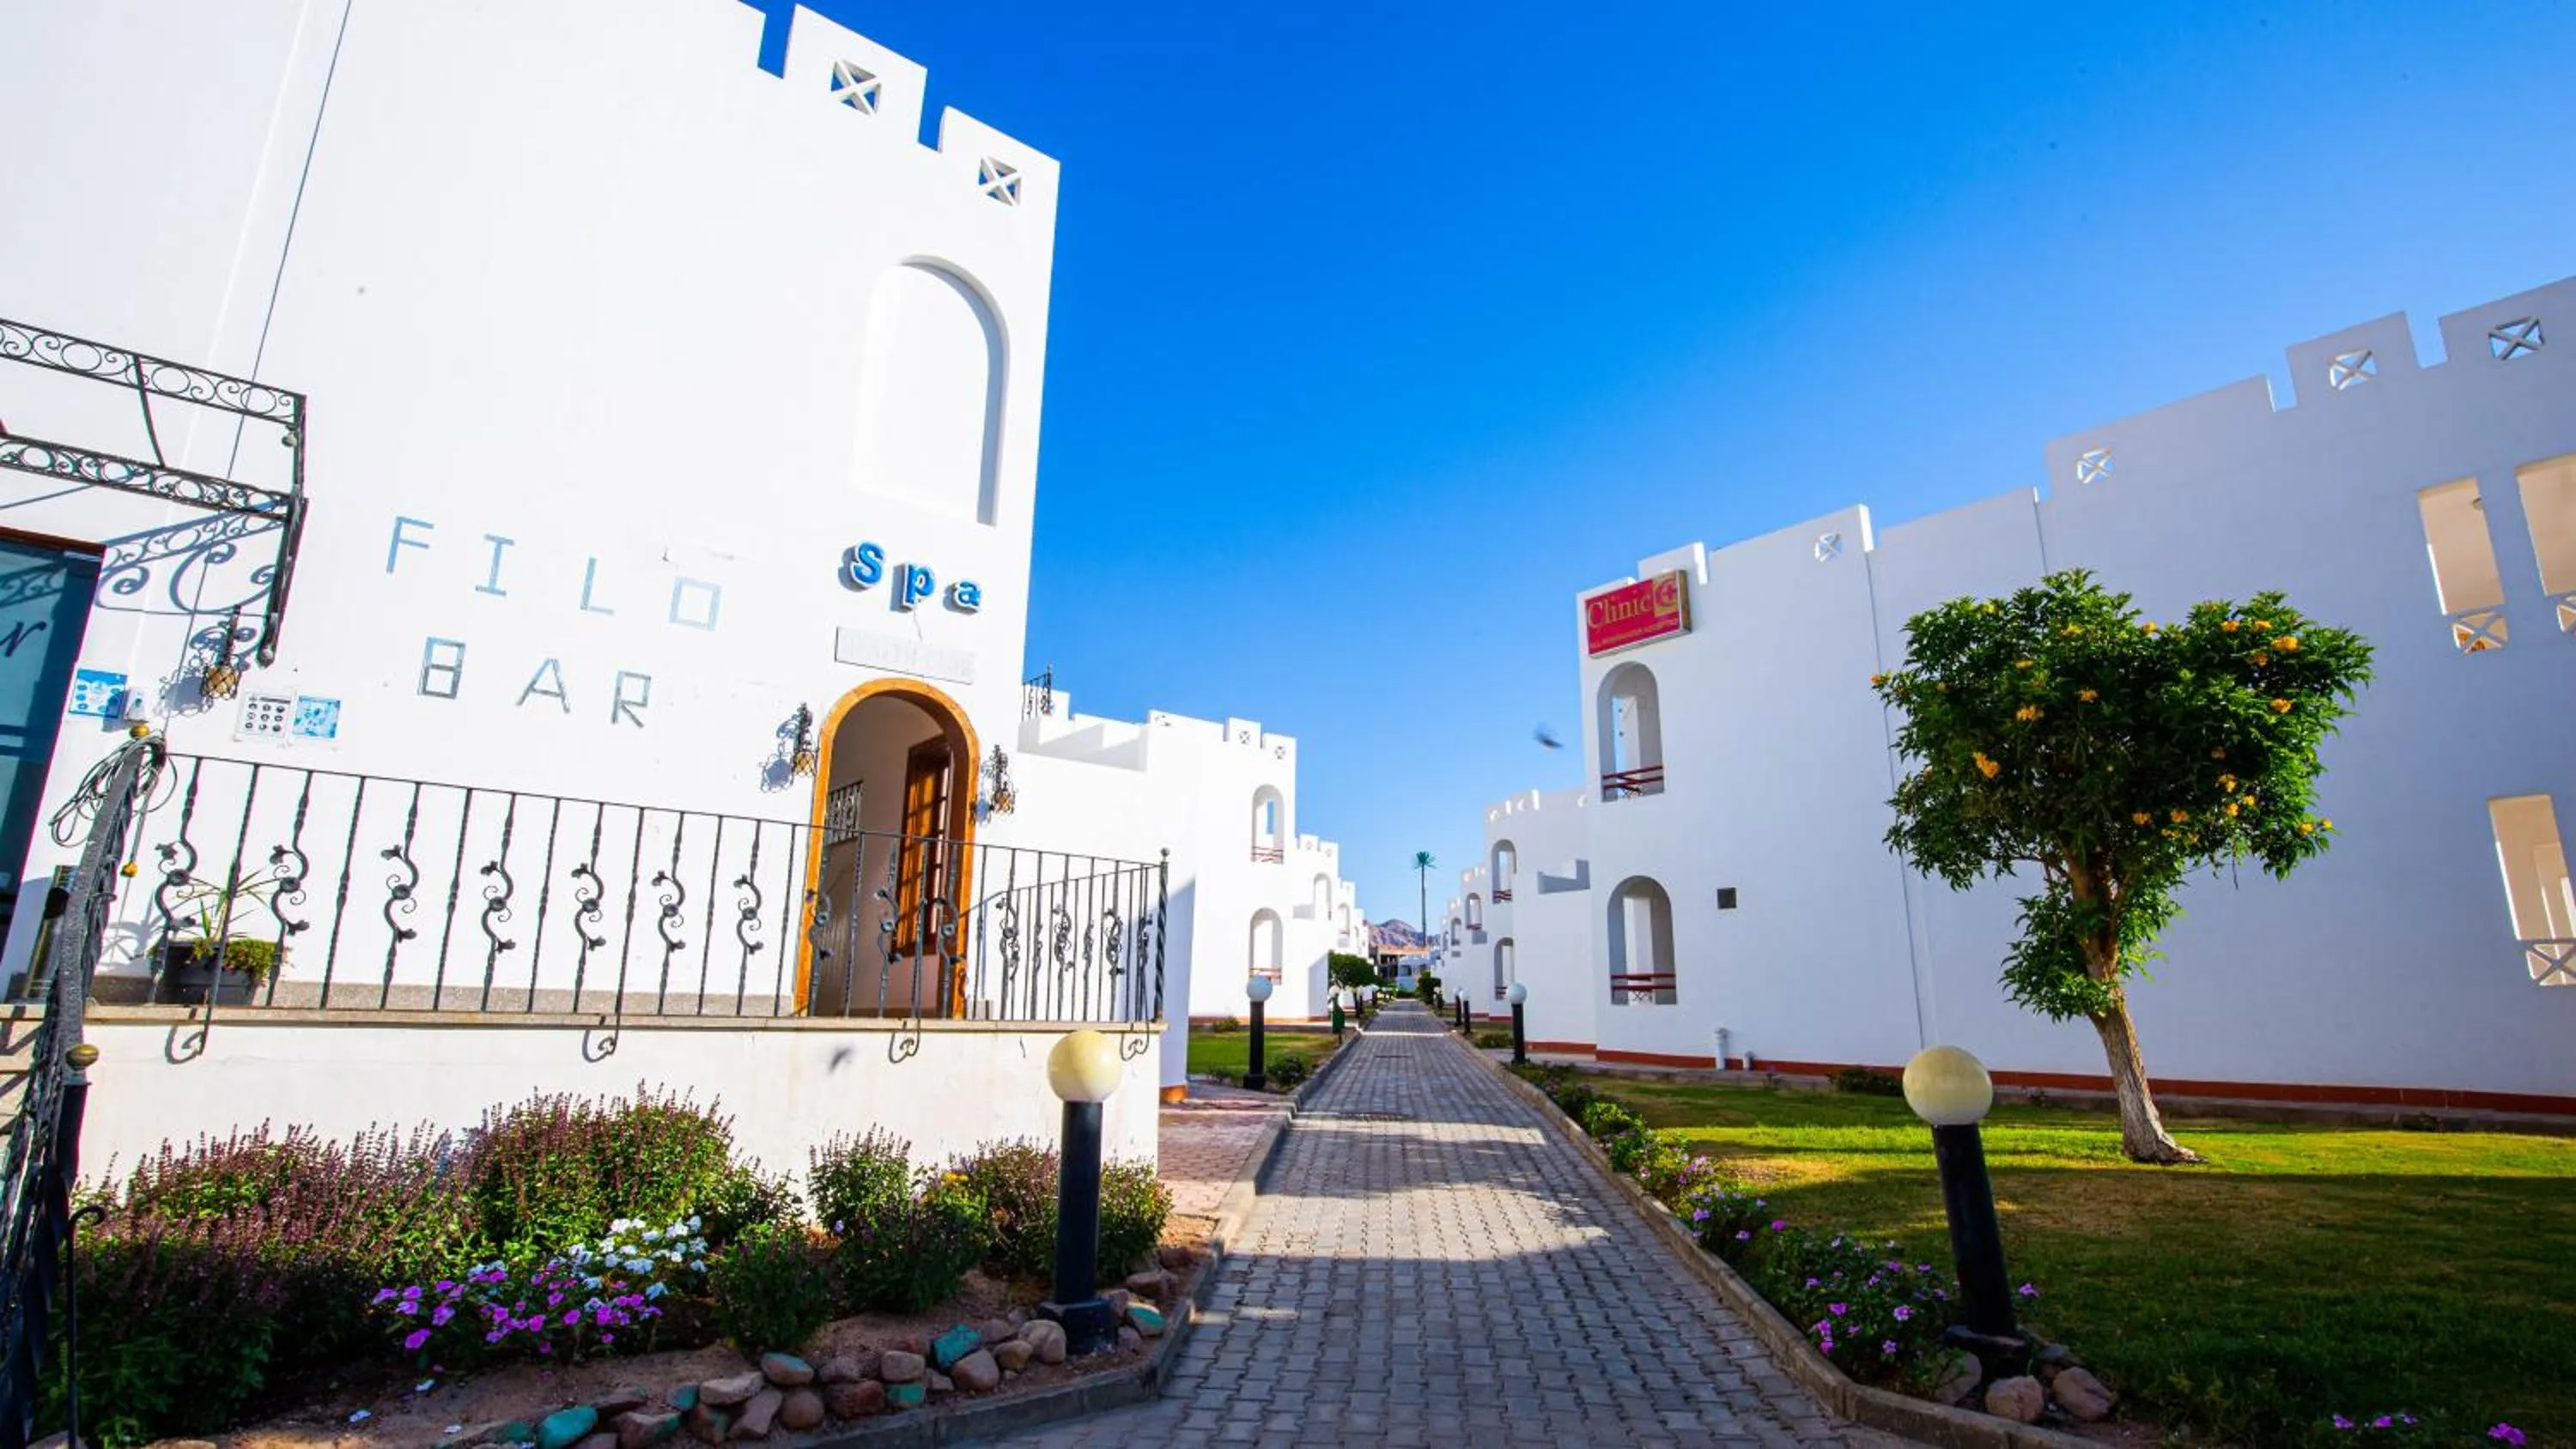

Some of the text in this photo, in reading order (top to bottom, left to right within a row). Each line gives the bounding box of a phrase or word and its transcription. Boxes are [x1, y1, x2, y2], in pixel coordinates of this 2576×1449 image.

[386, 516, 722, 631] FILO
[840, 542, 981, 613] Spa
[1589, 589, 1651, 627] Clinic
[418, 636, 651, 728] BAR
